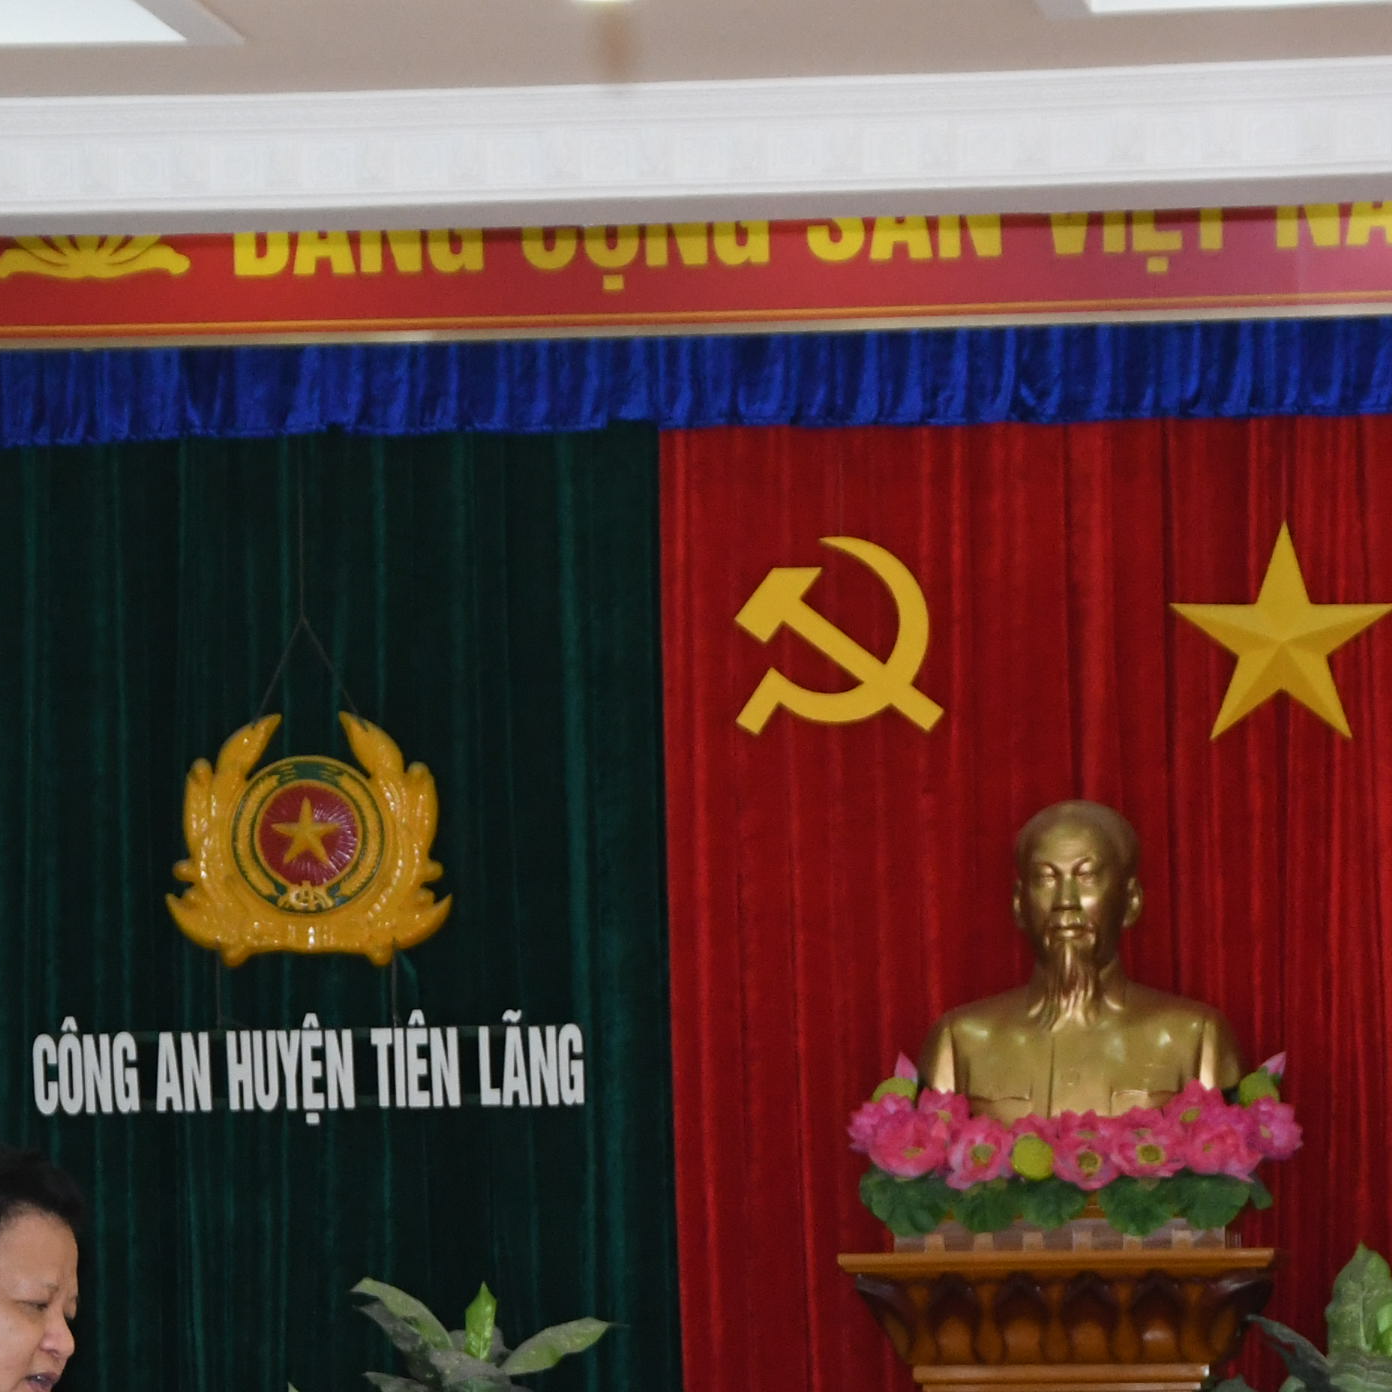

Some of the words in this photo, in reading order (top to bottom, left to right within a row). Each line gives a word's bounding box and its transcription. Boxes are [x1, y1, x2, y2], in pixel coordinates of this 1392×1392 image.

[32, 1016, 140, 1116] CÔNG
[156, 1031, 212, 1113] AN
[226, 1012, 356, 1125] HUYỆN
[370, 1009, 461, 1108] TIÊN
[478, 1009, 586, 1106] LÃNG
